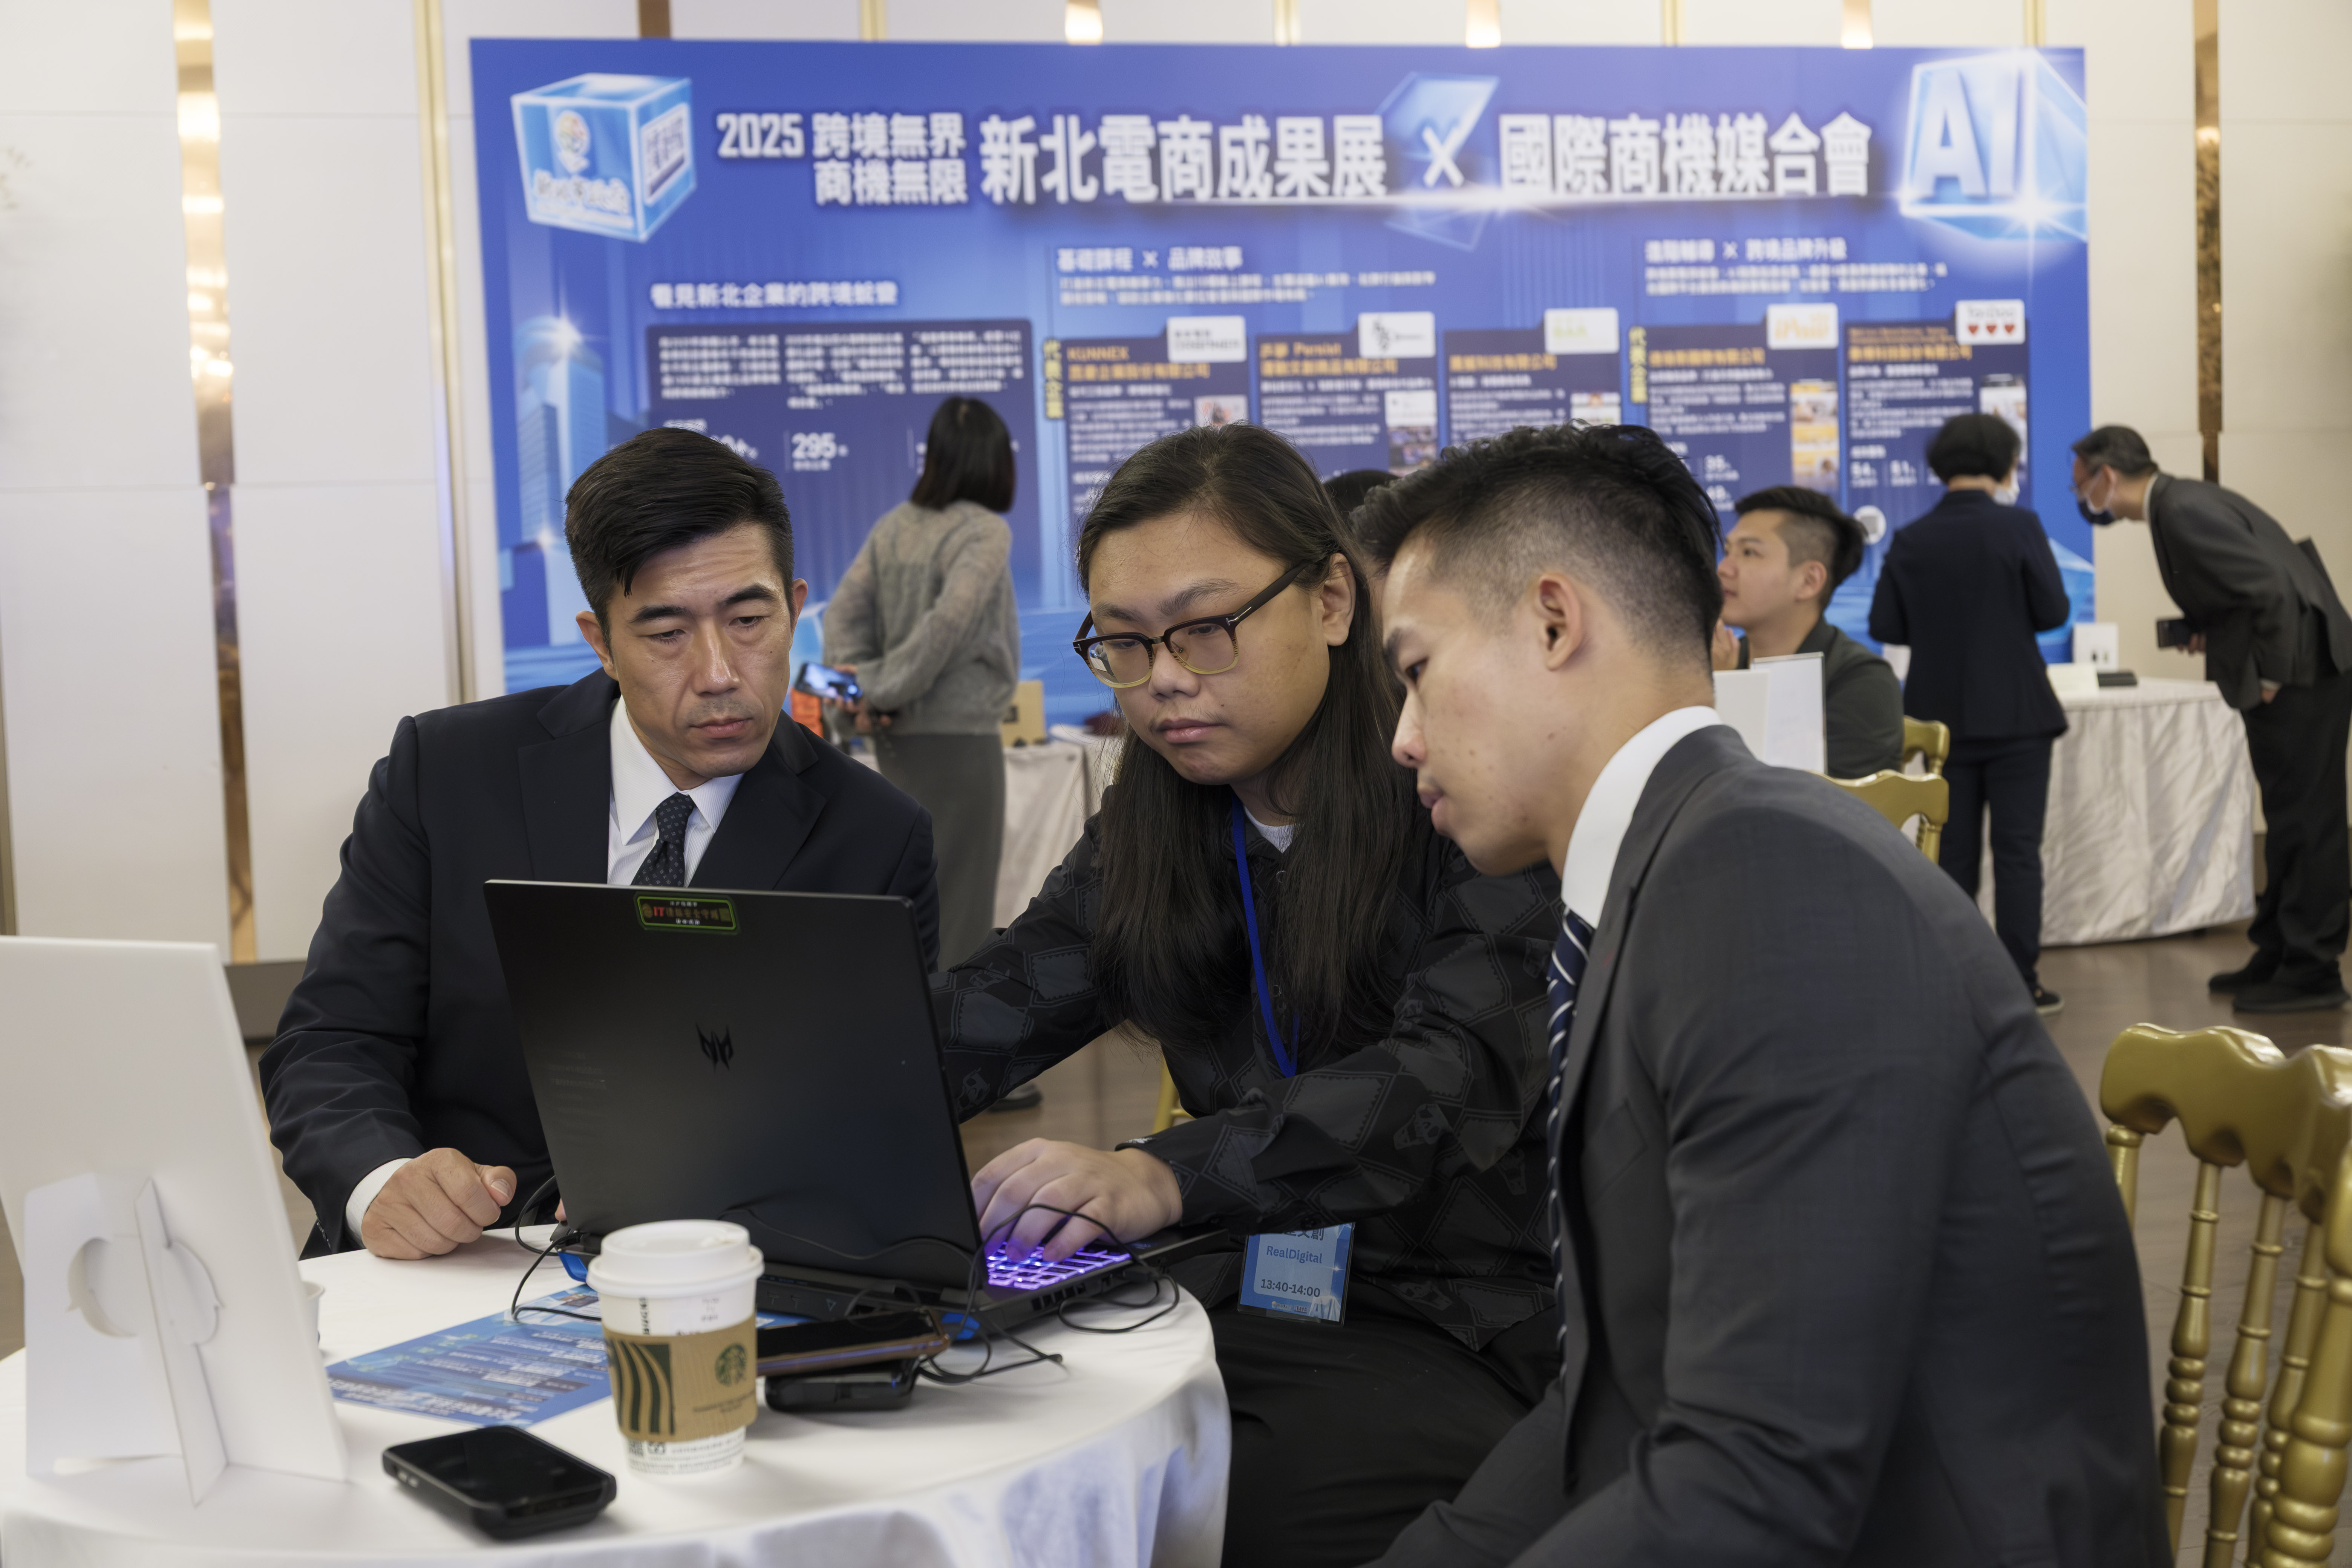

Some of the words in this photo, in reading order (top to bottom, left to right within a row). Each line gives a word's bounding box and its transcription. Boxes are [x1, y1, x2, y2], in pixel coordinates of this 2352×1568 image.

[717, 113, 804, 157] 2025
[812, 113, 966, 158] 跨境無界
[1909, 68, 2020, 198] AI
[980, 115, 1387, 203] 新北電商成果展
[1498, 112, 1871, 196] 國際商機媒合會
[813, 158, 968, 206] 商機無限
[1266, 1245, 1322, 1263] RealDigital
[1283, 1228, 1325, 1241] 文創
[1260, 1279, 1320, 1297] 13:40-14:00
